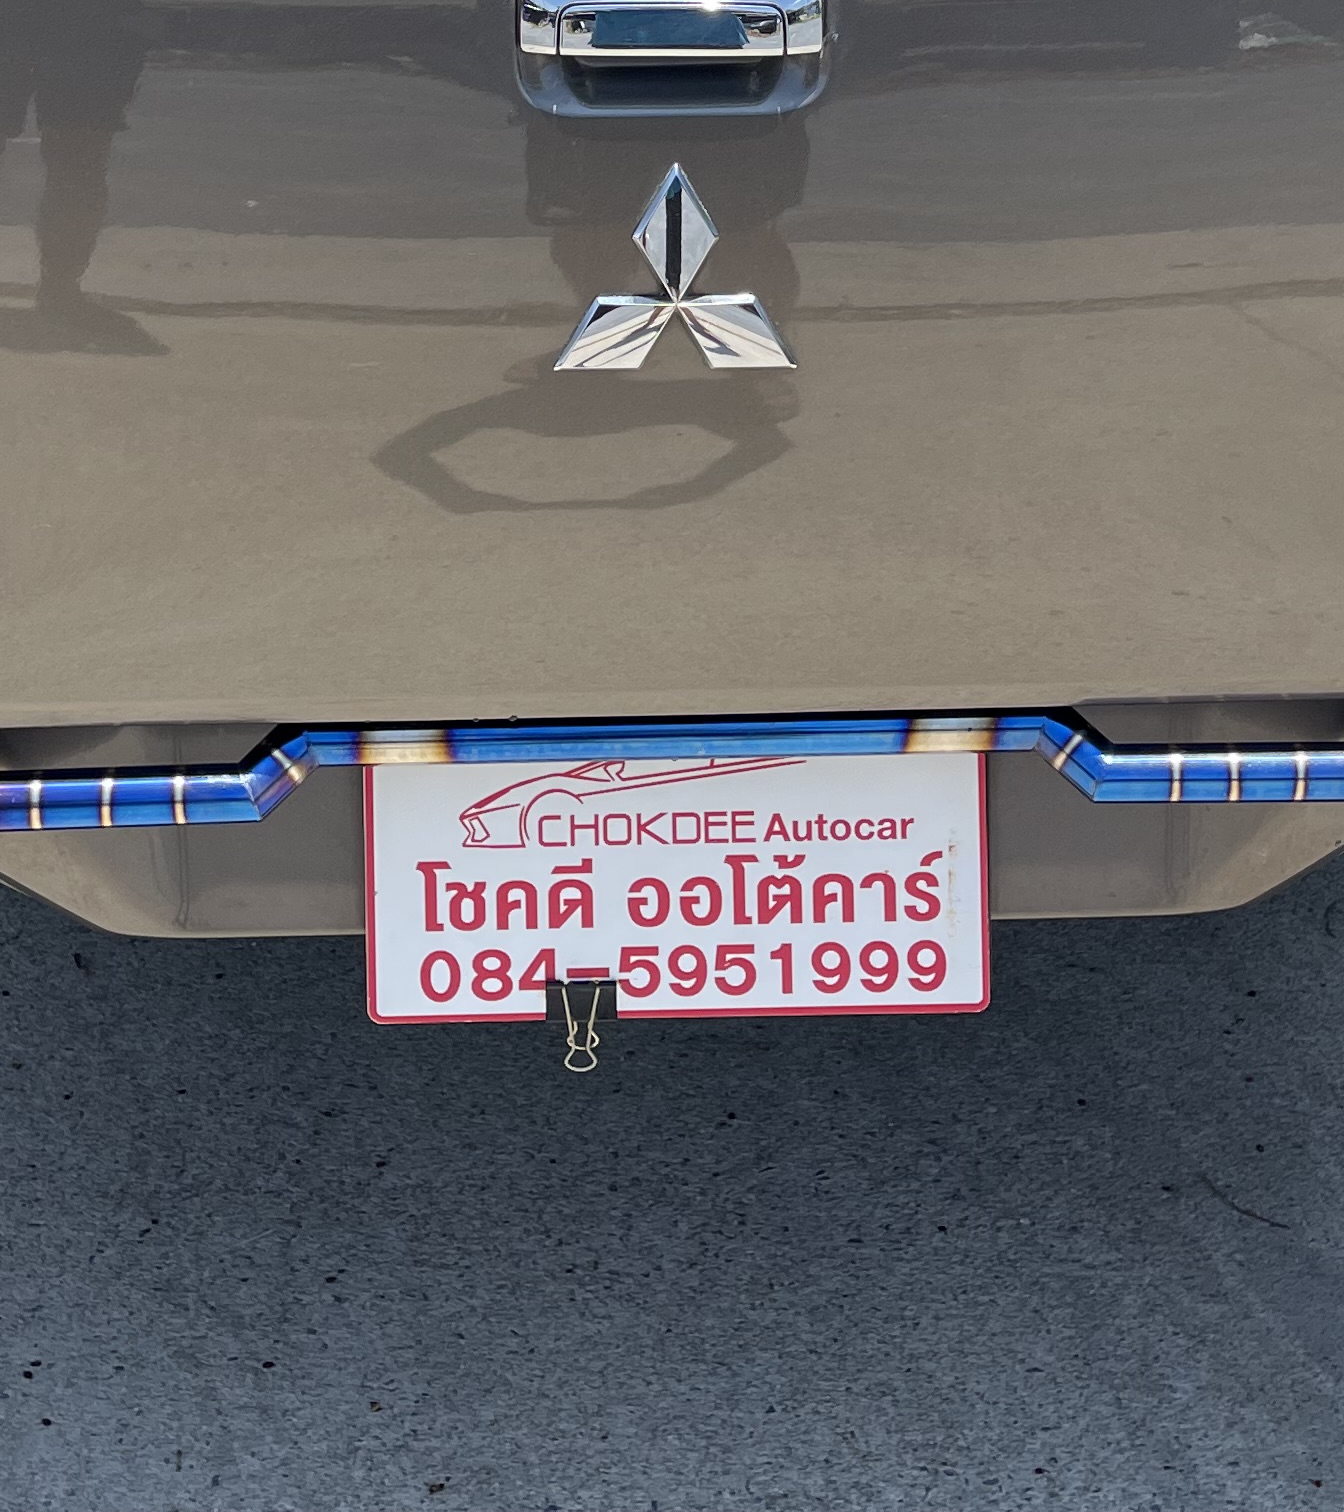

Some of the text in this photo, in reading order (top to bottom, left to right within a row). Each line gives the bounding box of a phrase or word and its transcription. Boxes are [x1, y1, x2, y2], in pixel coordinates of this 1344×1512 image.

[537, 810, 915, 848] CHOKDEE Autocar
[416, 850, 943, 932] โชคดี ออโต้คาร์
[420, 939, 947, 1003] 084-5951999
